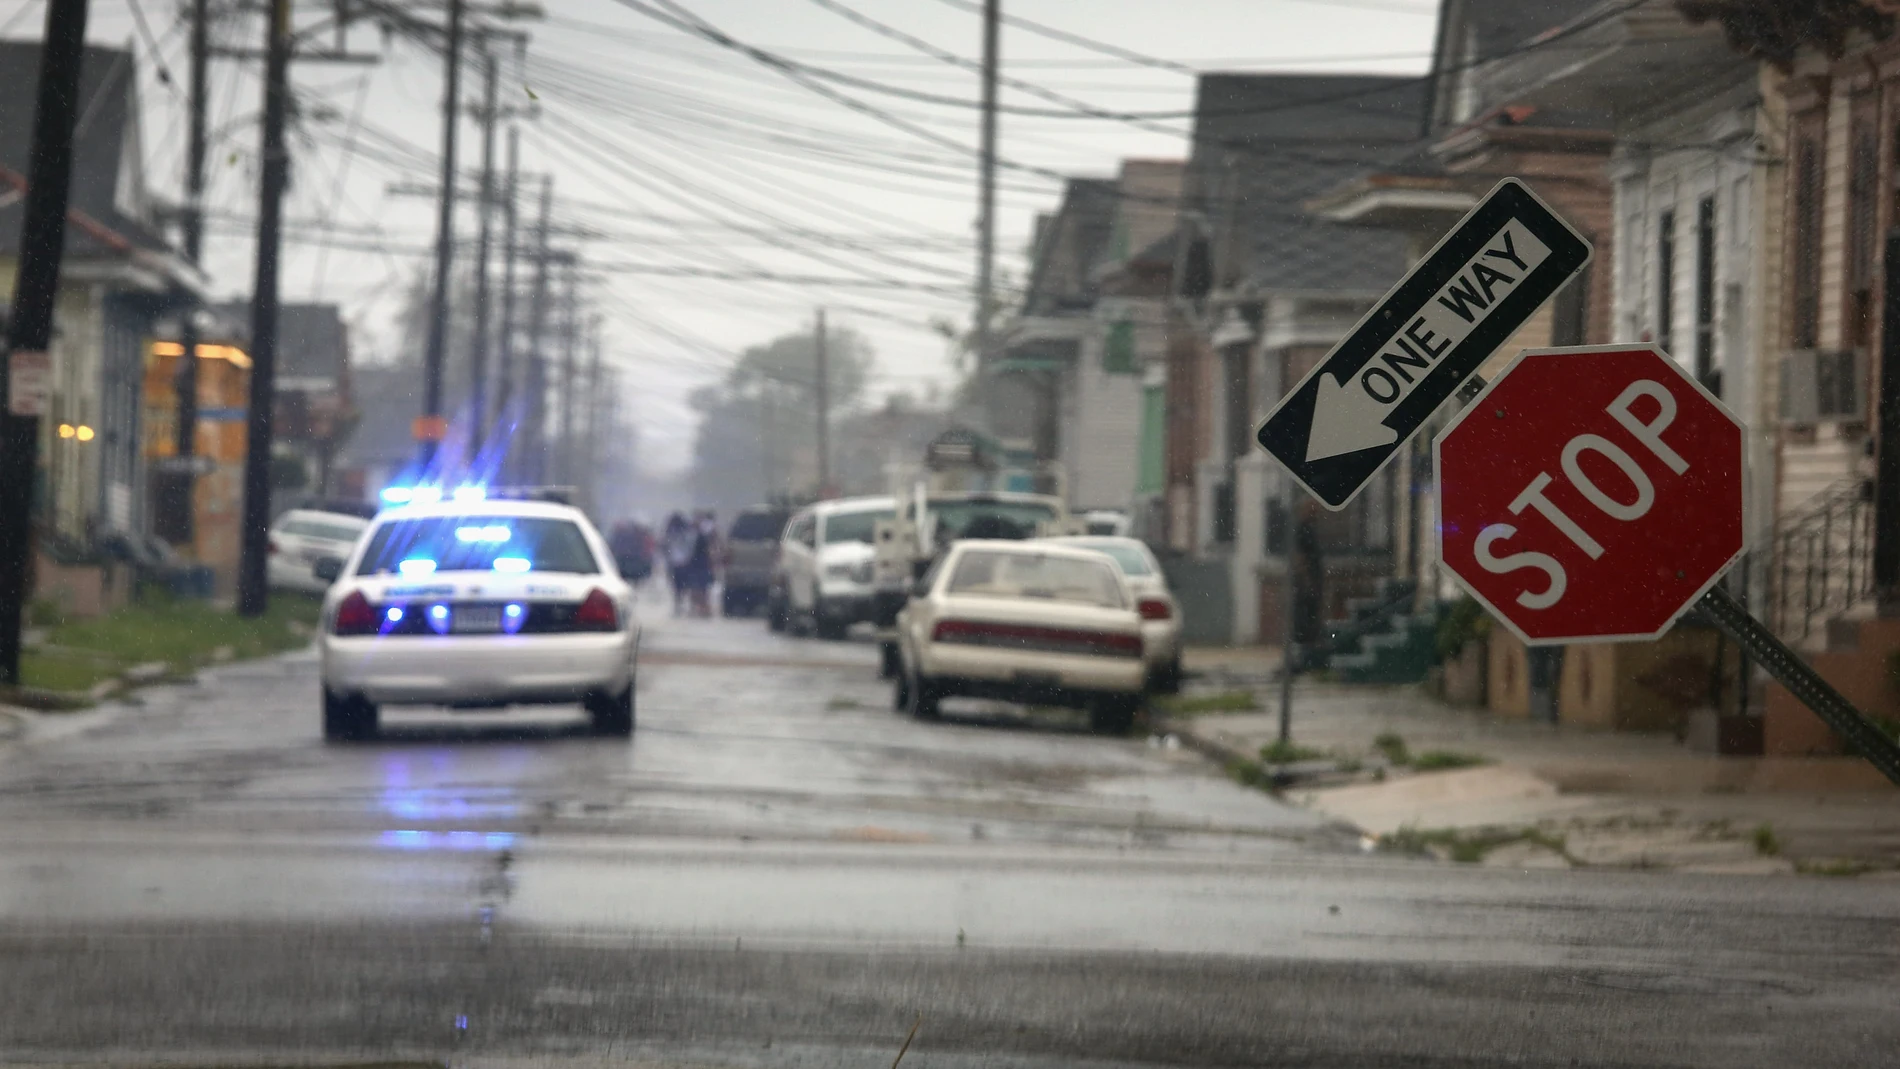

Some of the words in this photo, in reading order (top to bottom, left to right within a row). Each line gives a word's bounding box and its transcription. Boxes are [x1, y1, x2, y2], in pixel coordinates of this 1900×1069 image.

[1361, 316, 1451, 404] ONE
[1438, 230, 1529, 323] WAY
[1474, 379, 1690, 610] STOP
